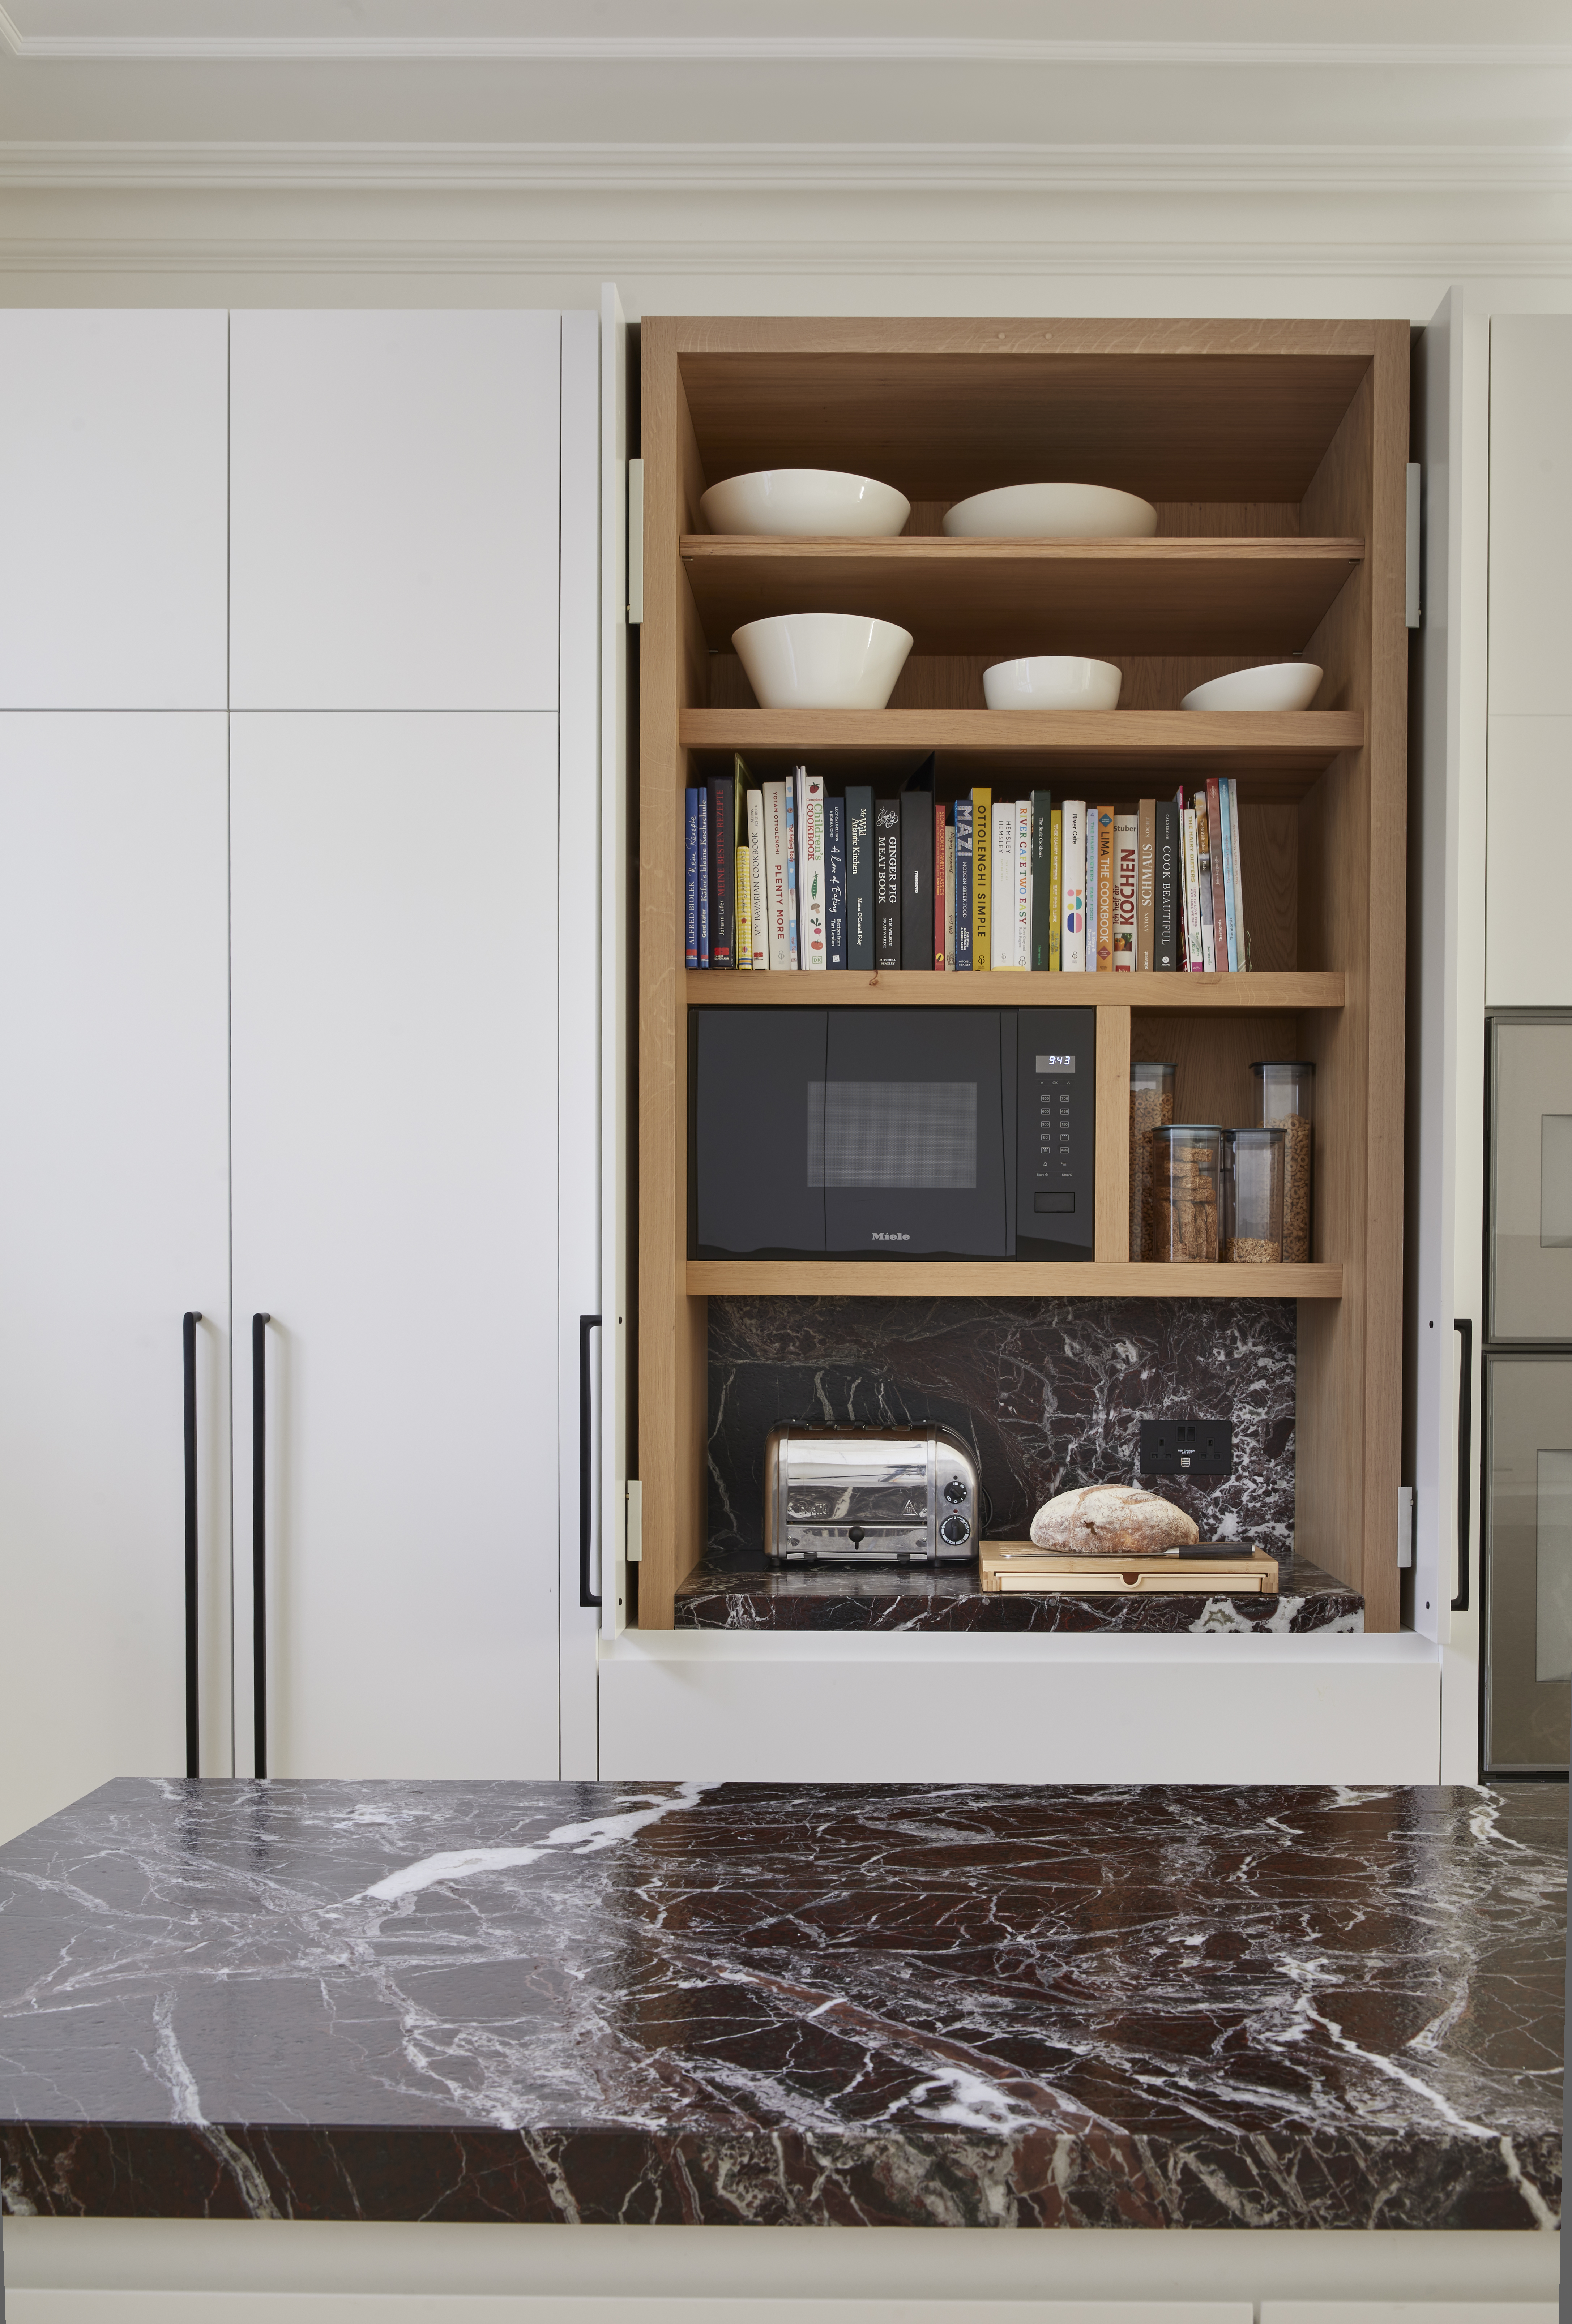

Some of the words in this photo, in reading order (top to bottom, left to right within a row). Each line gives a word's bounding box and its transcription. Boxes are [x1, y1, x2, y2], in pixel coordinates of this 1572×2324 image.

[860, 809, 866, 818] My
[685, 814, 698, 849] Rezepte
[814, 803, 823, 860] Children's
[957, 806, 972, 857] MAZI
[978, 805, 986, 886] OTTOLENGHI
[1101, 832, 1110, 856] LIMA
[688, 851, 697, 877] Meine
[831, 855, 841, 873] Love
[1101, 858, 1109, 878] THE
[1142, 844, 1152, 906] SCHMAUS
[775, 865, 783, 905] PLENTY
[829, 886, 841, 913] Eating
[1120, 849, 1135, 925] KOCHEN
[1100, 881, 1109, 943] COOKBOOK
[1162, 883, 1171, 945] BEAUTIFUL
[755, 924, 761, 936] MY
[1049, 1056, 1070, 1065] 9:43
